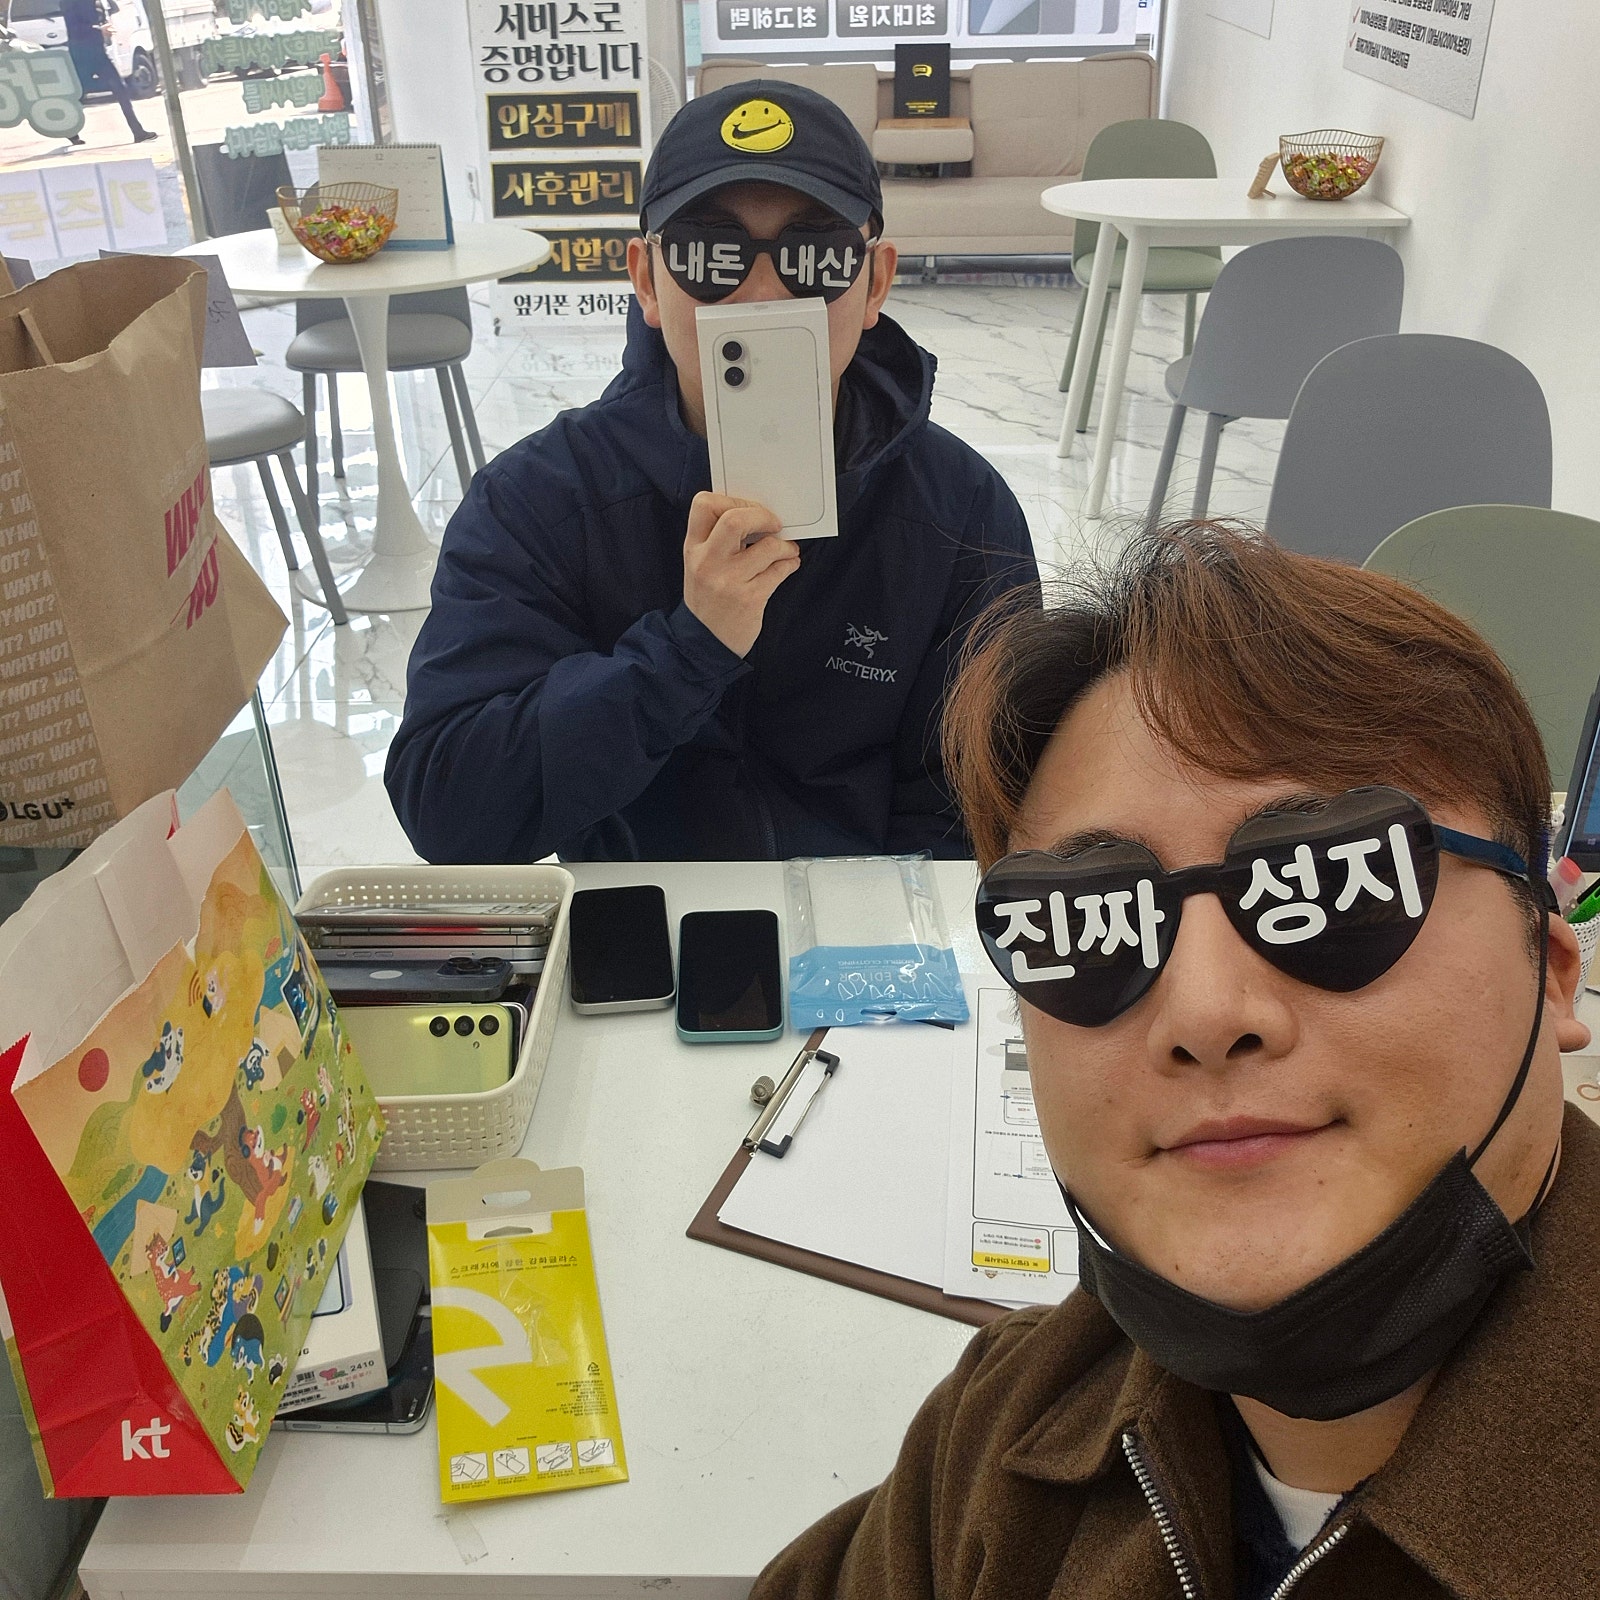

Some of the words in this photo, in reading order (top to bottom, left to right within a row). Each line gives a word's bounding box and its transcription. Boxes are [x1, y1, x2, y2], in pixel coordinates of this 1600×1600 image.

[495, 2, 625, 40] 서비스로
[480, 42, 644, 83] 증명합니다
[498, 102, 631, 139] 안심구매
[502, 170, 634, 207] 사후관리
[520, 237, 628, 273] 지할인
[669, 240, 745, 286] 내돈
[780, 244, 858, 288] 내산
[513, 293, 571, 317] 옆커폰
[993, 878, 1165, 983] 진짜
[1239, 823, 1424, 945] 성지
[350, 1360, 375, 1372] 2410
[121, 1417, 171, 1461] kt
